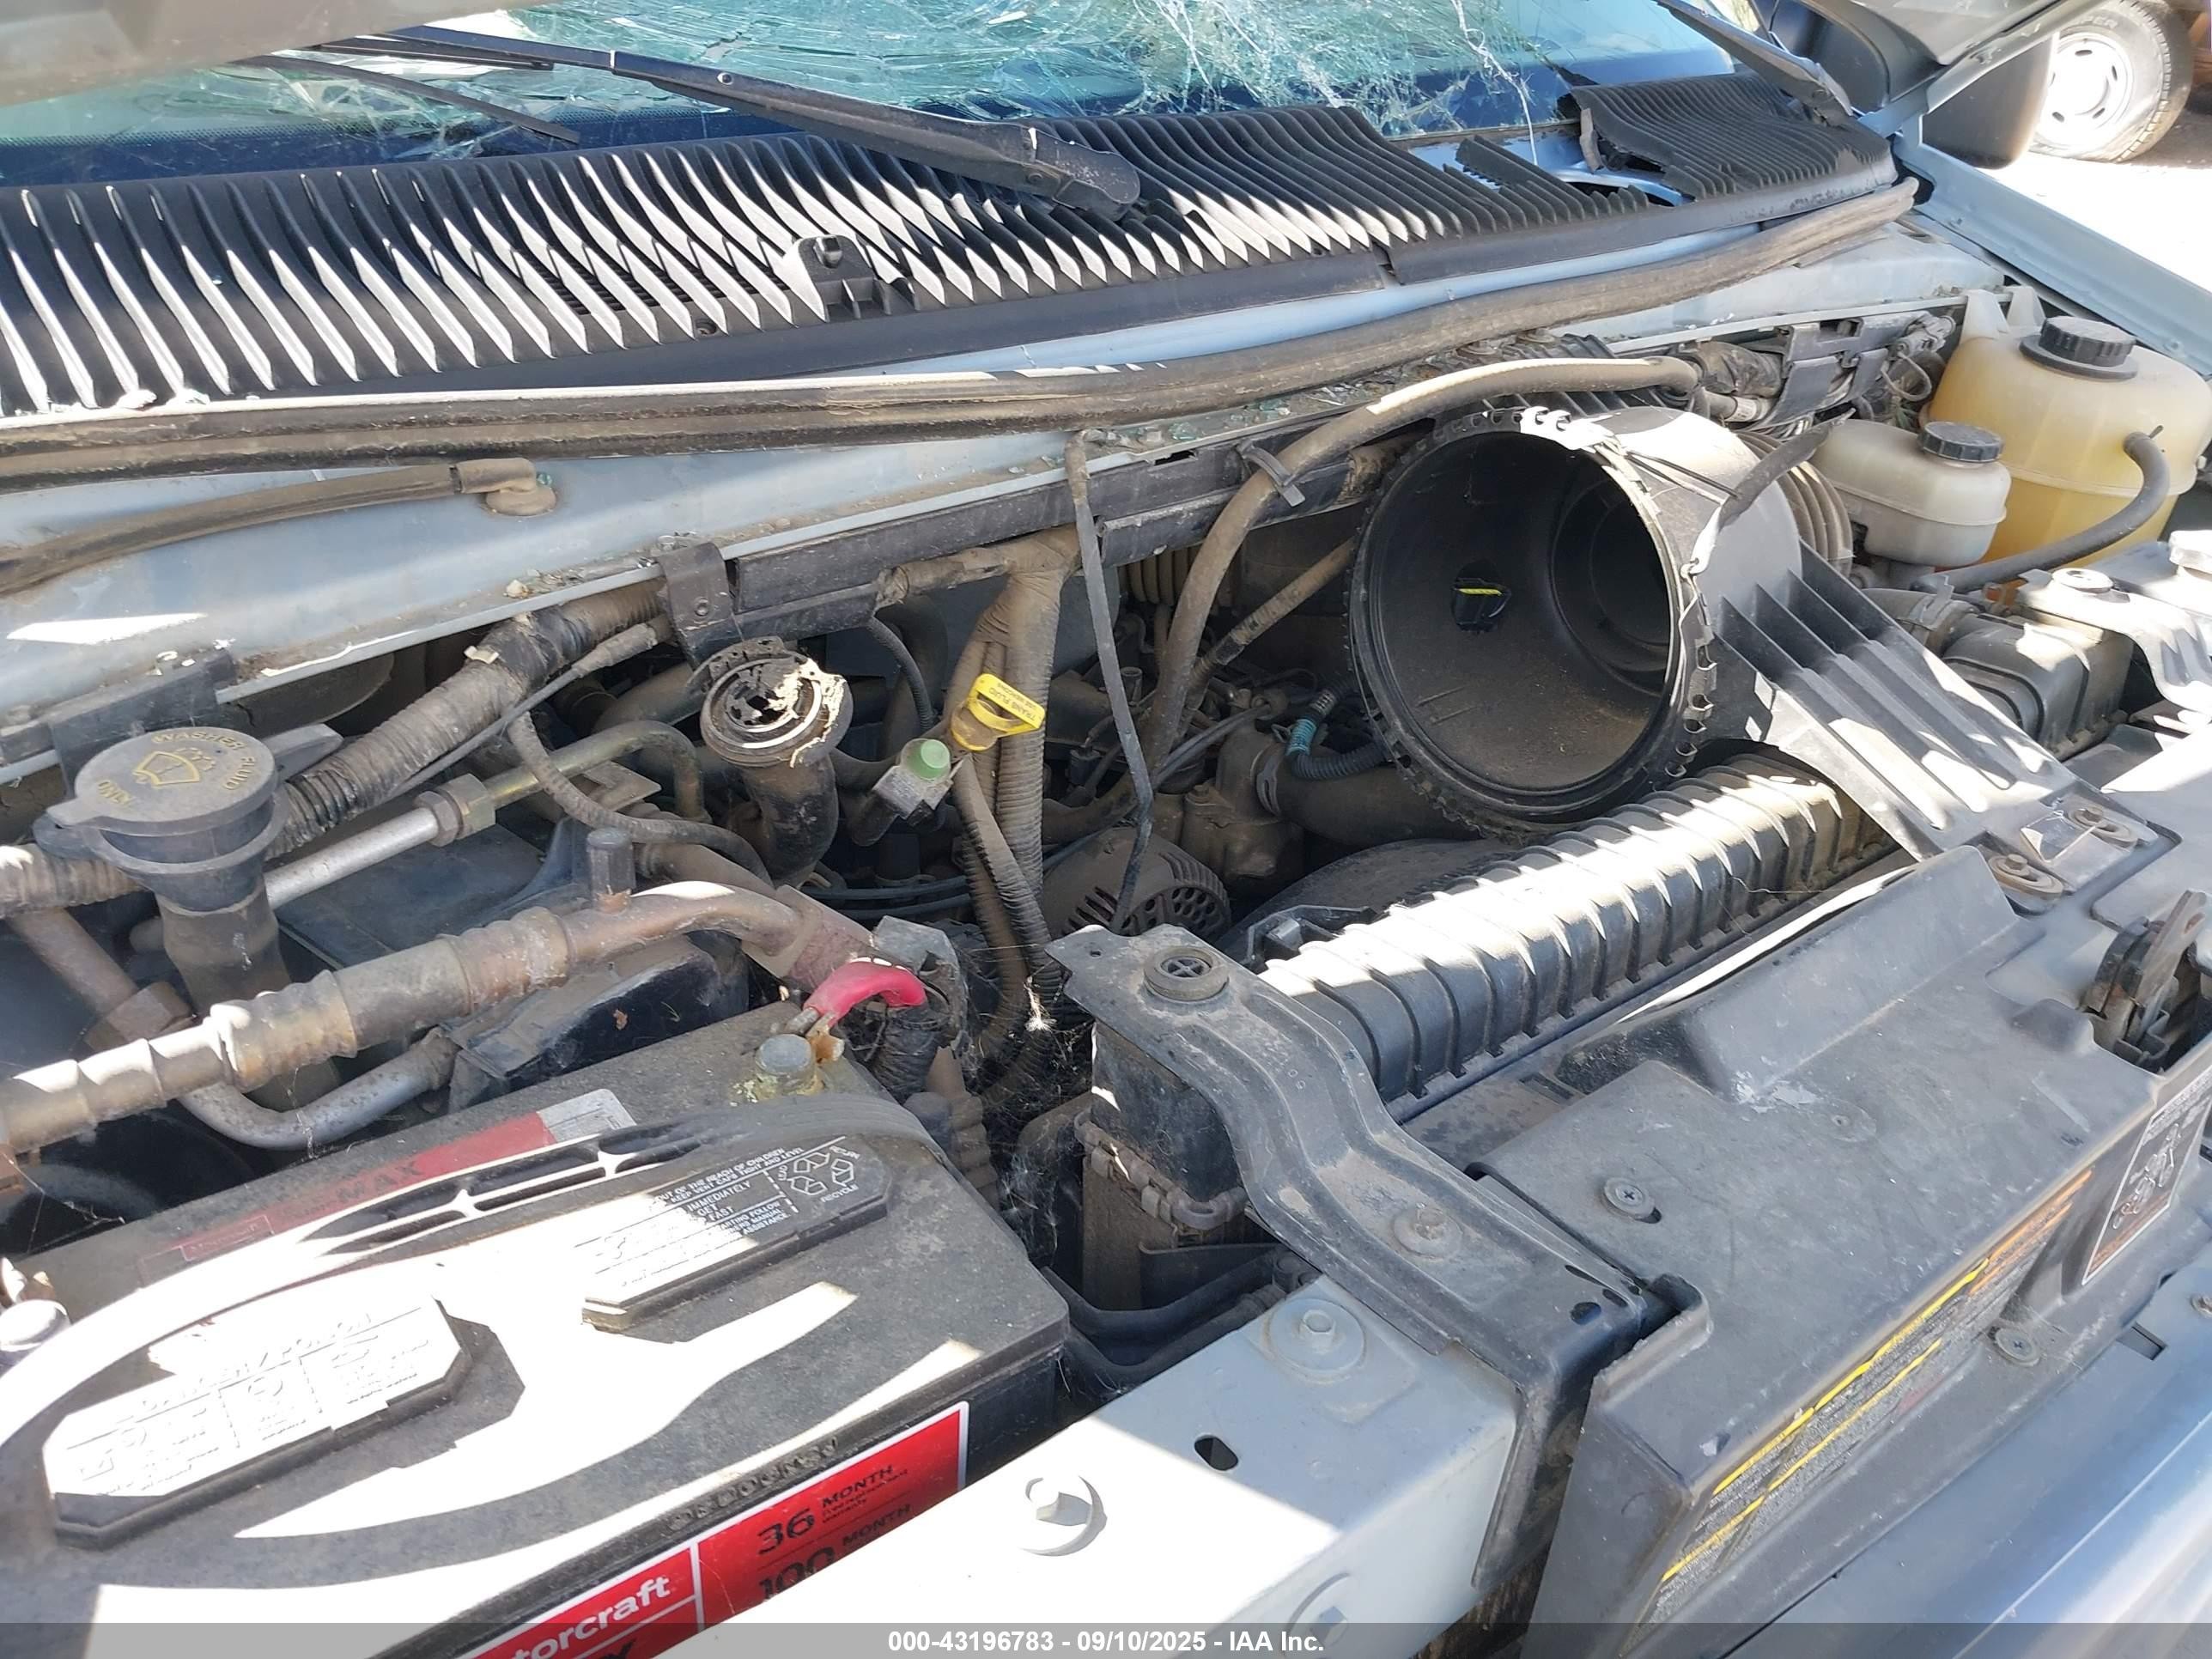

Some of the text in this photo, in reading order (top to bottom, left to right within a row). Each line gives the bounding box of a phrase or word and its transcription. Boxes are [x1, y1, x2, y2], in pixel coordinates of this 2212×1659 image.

[97, 731, 257, 804] WASHER FLUID ONLY
[670, 1191, 692, 1203] KEEP
[763, 1156, 781, 1167] AND
[781, 1146, 805, 1159] LEVEL
[674, 1186, 687, 1195] OF
[706, 1168, 734, 1183] REACH
[733, 1163, 745, 1172] OF
[746, 1147, 785, 1167] CHILDREN
[686, 1180, 751, 1212] IMMEDIATELY
[697, 1203, 719, 1217] GET
[708, 1206, 735, 1221] FAST
[749, 1200, 781, 1218] FOLLOW
[820, 1183, 860, 1203] RECYCLE
[822, 1464, 893, 1509] MONTH
[757, 1507, 815, 1555] 36
[841, 1504, 911, 1546] MONTH
[758, 1546, 836, 1601] 100
